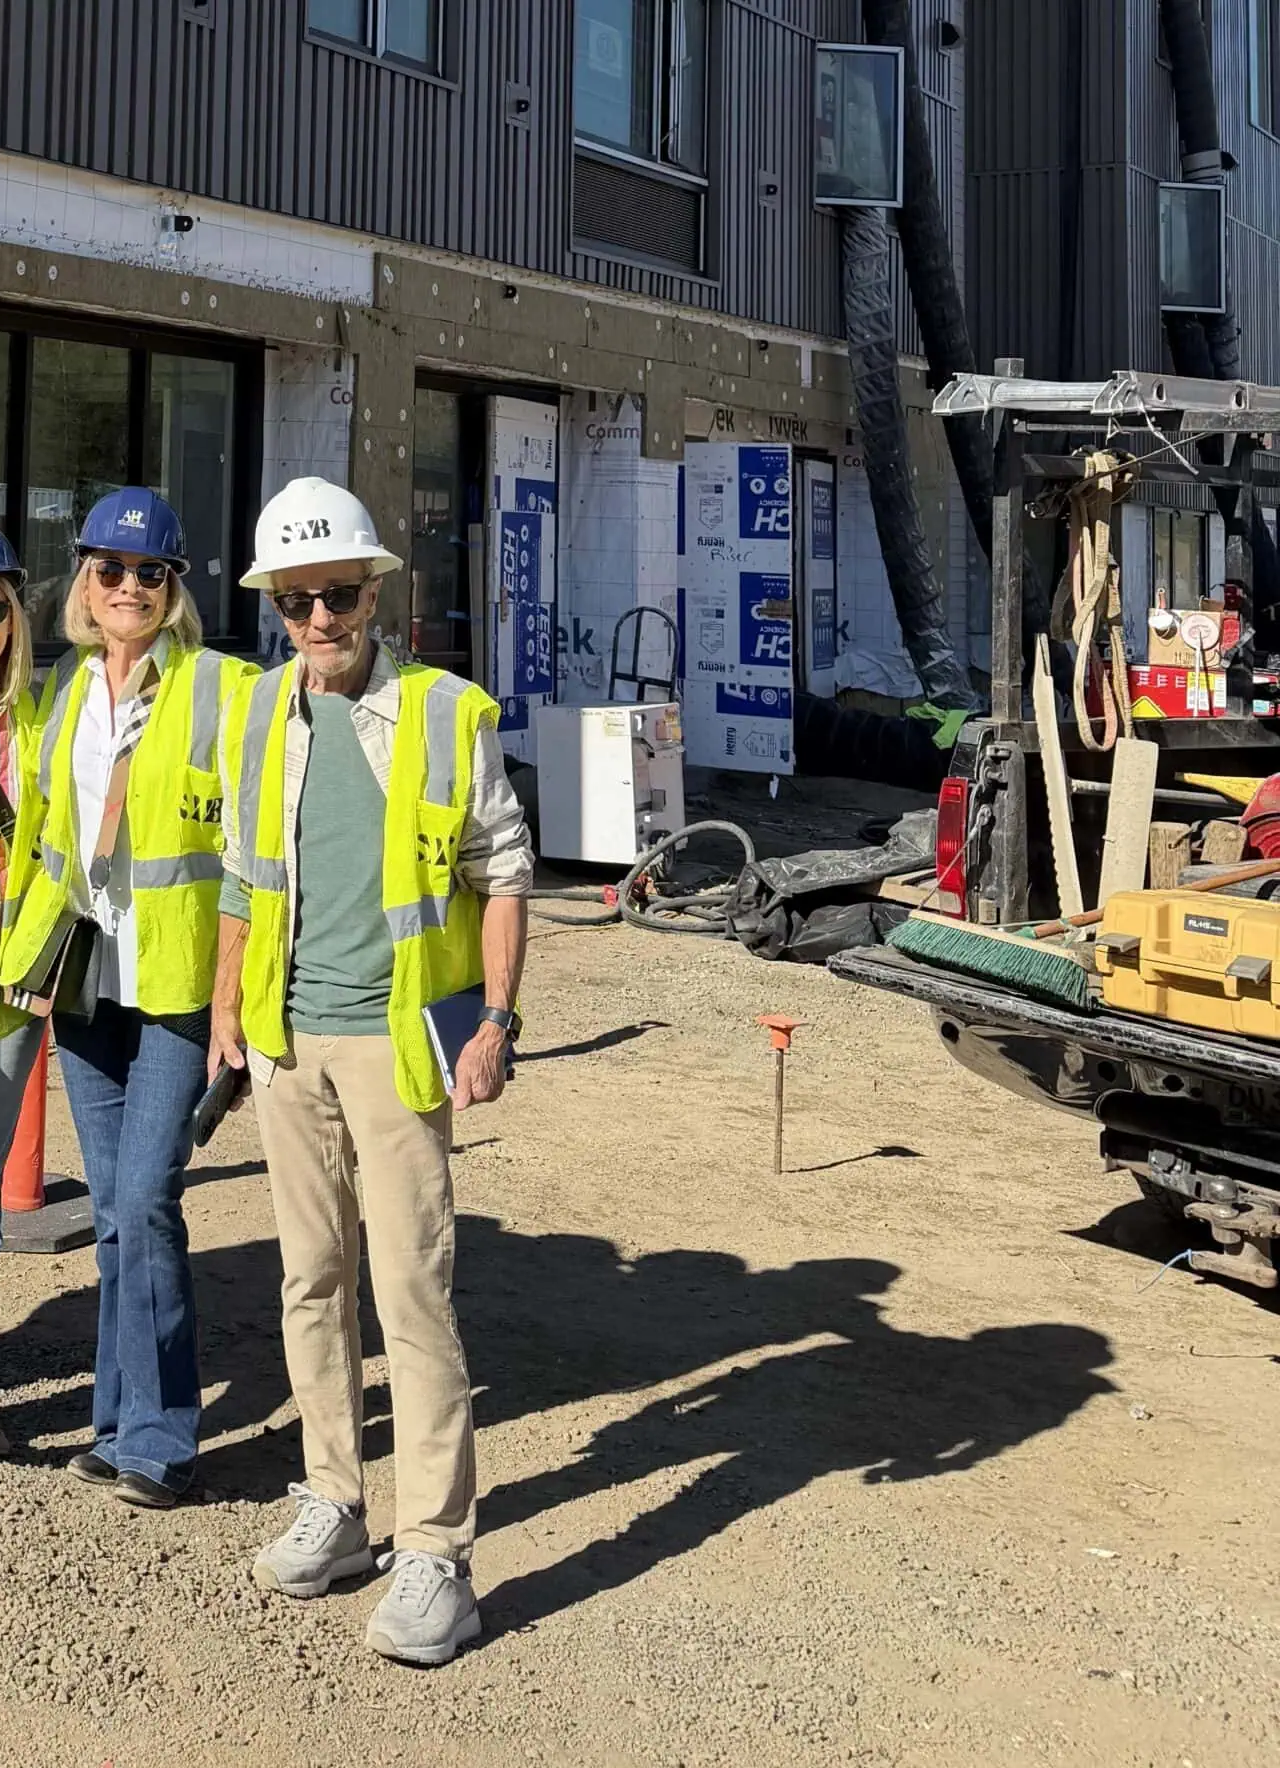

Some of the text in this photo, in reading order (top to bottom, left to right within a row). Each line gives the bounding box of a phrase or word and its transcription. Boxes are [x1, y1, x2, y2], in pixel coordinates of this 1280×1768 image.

[697, 536, 725, 547] Henry
[698, 660, 726, 673] Henry
[726, 727, 737, 756] Henry
